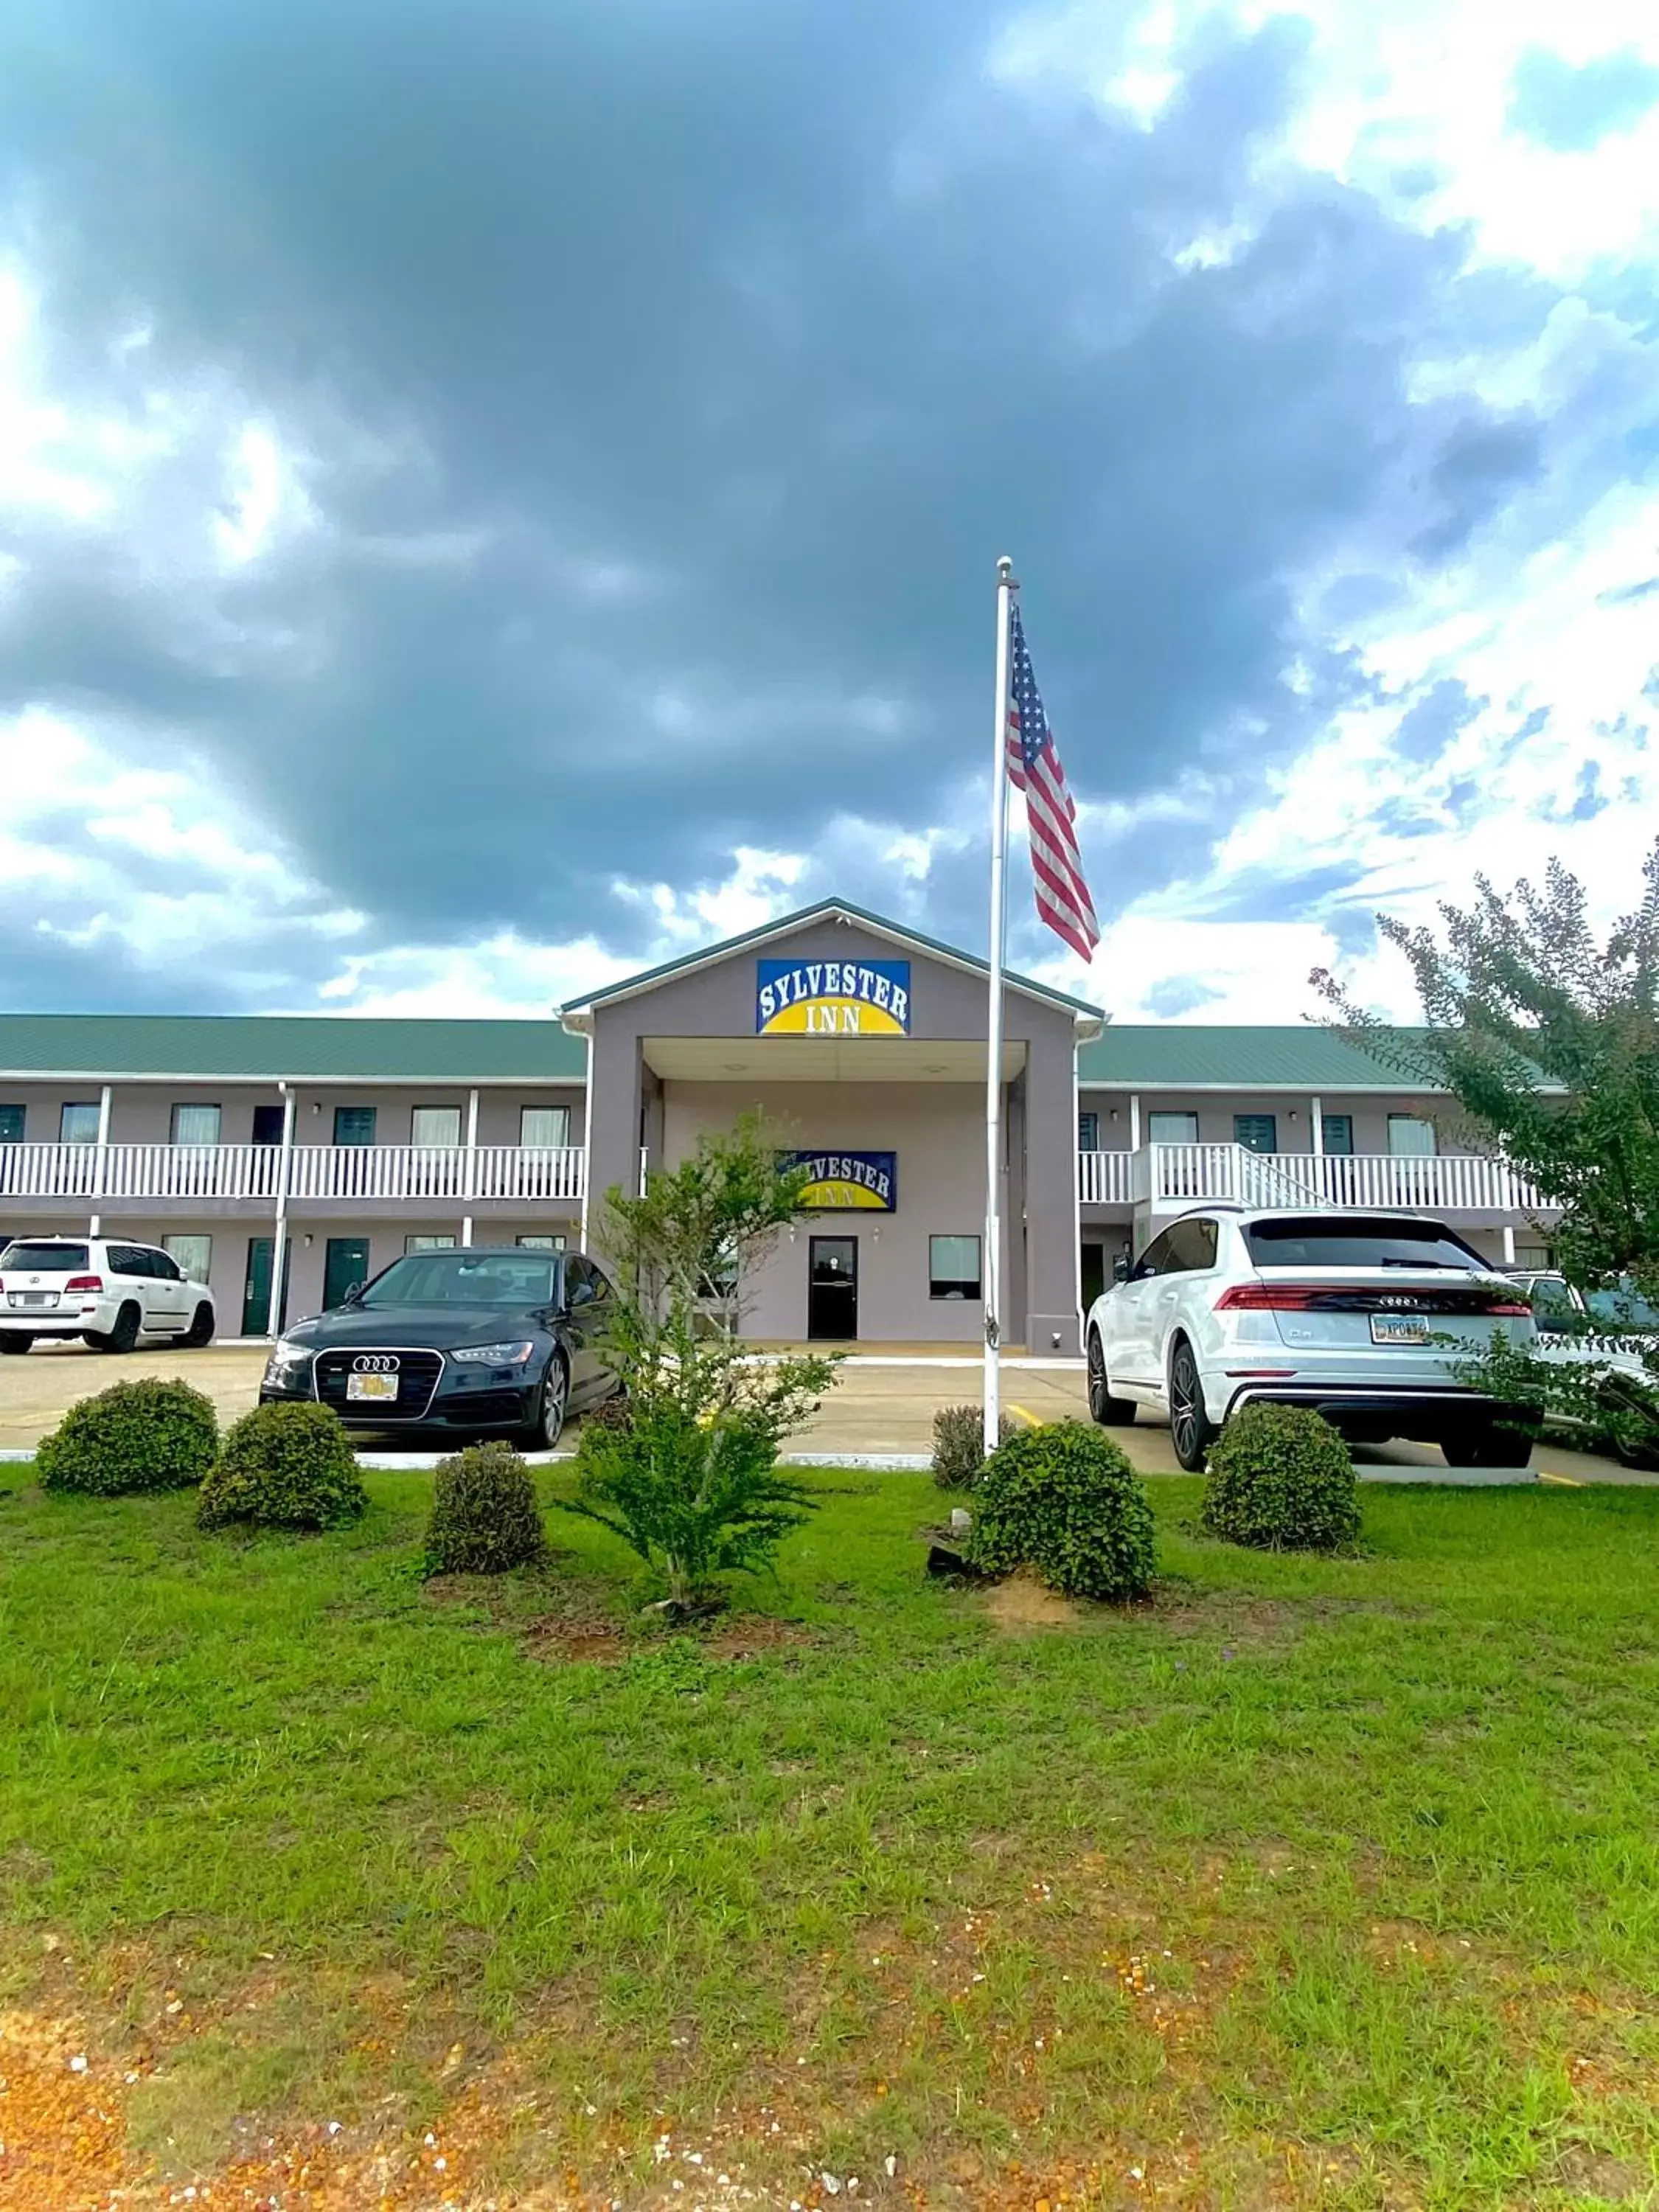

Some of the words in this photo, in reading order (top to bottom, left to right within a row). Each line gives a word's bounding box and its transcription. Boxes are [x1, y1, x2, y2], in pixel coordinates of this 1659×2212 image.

[759, 963, 908, 1021] SYLVESTER
[806, 1006, 860, 1033] INN
[780, 1157, 890, 1197] LVESTER
[815, 1186, 854, 1206] INN
